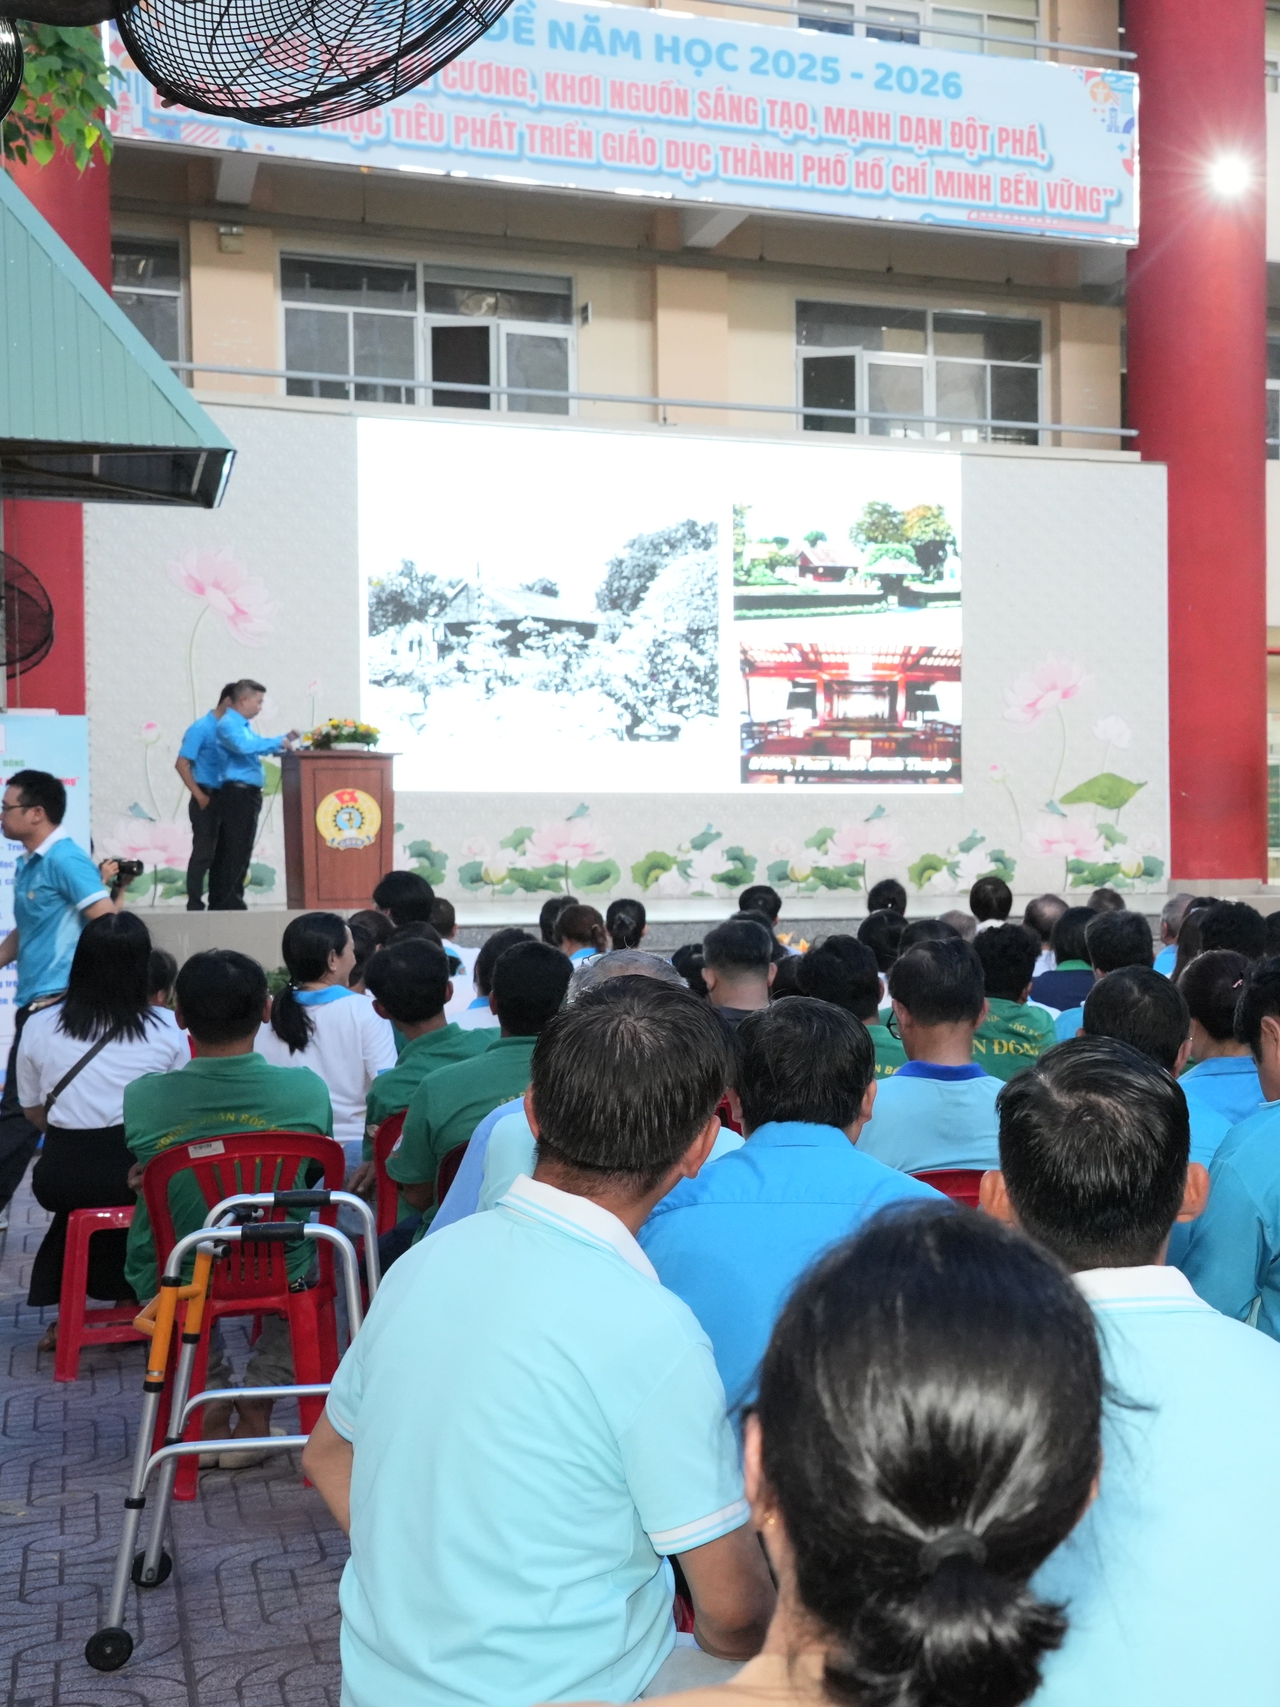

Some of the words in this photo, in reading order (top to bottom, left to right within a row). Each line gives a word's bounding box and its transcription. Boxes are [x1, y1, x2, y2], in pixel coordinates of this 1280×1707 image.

[548, 13, 642, 60] NĂM
[654, 33, 739, 78] HỌC
[749, 46, 841, 85] 2025
[850, 71, 865, 80] -
[873, 62, 963, 100] 2026
[391, 102, 446, 143] TIÊU
[453, 113, 518, 151] PHÁT
[525, 120, 593, 160] TRIỂN
[601, 127, 658, 167] GIÁO
[665, 139, 712, 177] DỤC
[719, 142, 794, 182] THÀNH
[802, 152, 849, 186] PHỐ
[854, 156, 885, 191] HỒ
[891, 161, 928, 195] CHÍ
[934, 169, 992, 203] MINH
[999, 171, 1039, 207] BỀN
[442, 59, 537, 104] CƯƠNG,
[545, 71, 602, 107] KHƠI
[610, 79, 690, 117] NGUỒN
[697, 85, 759, 126] SÁNG
[766, 98, 816, 136] TẠO,
[824, 105, 891, 143] MẠNH
[900, 114, 943, 150] DẠN
[950, 116, 990, 157] ĐỘT
[997, 123, 1047, 162] PHÁ,
